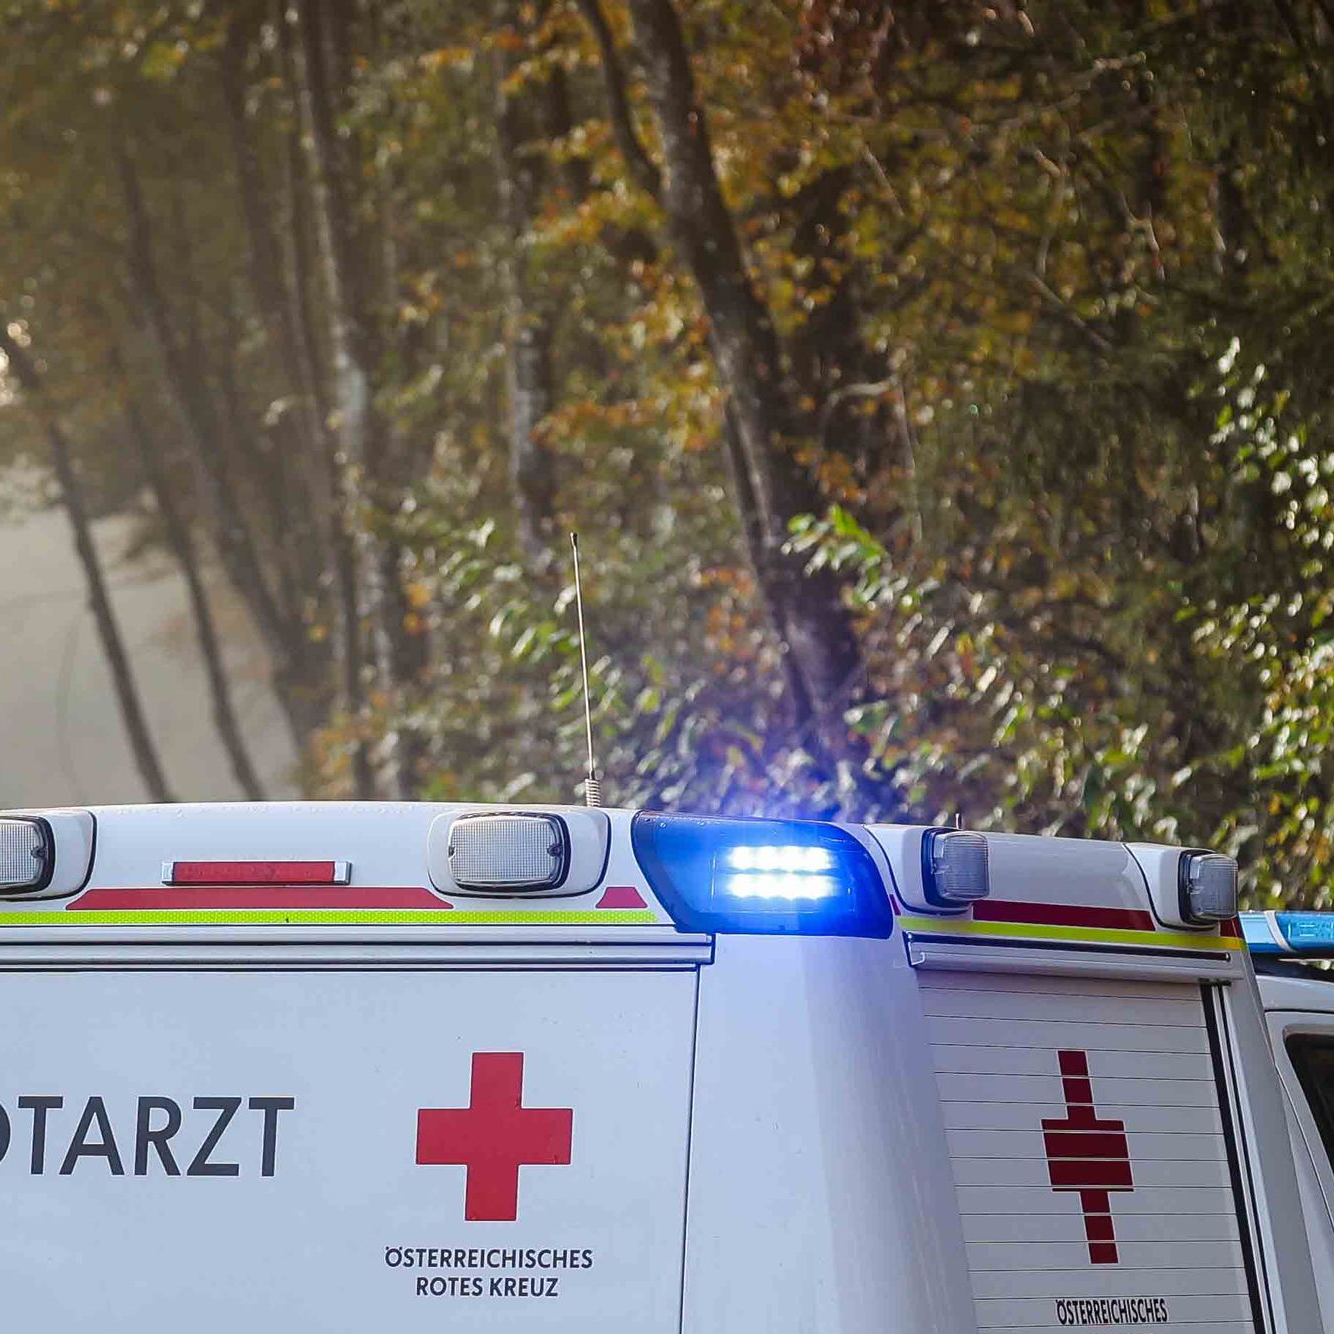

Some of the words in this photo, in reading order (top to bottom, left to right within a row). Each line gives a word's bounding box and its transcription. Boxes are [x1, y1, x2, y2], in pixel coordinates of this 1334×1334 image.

[385, 1247, 593, 1269] ÖSTERREICHISCHES
[416, 1276, 483, 1297] ROTES
[489, 1277, 559, 1297] KREUZ
[1056, 1298, 1168, 1325] ÖSTERREICHISCHES
